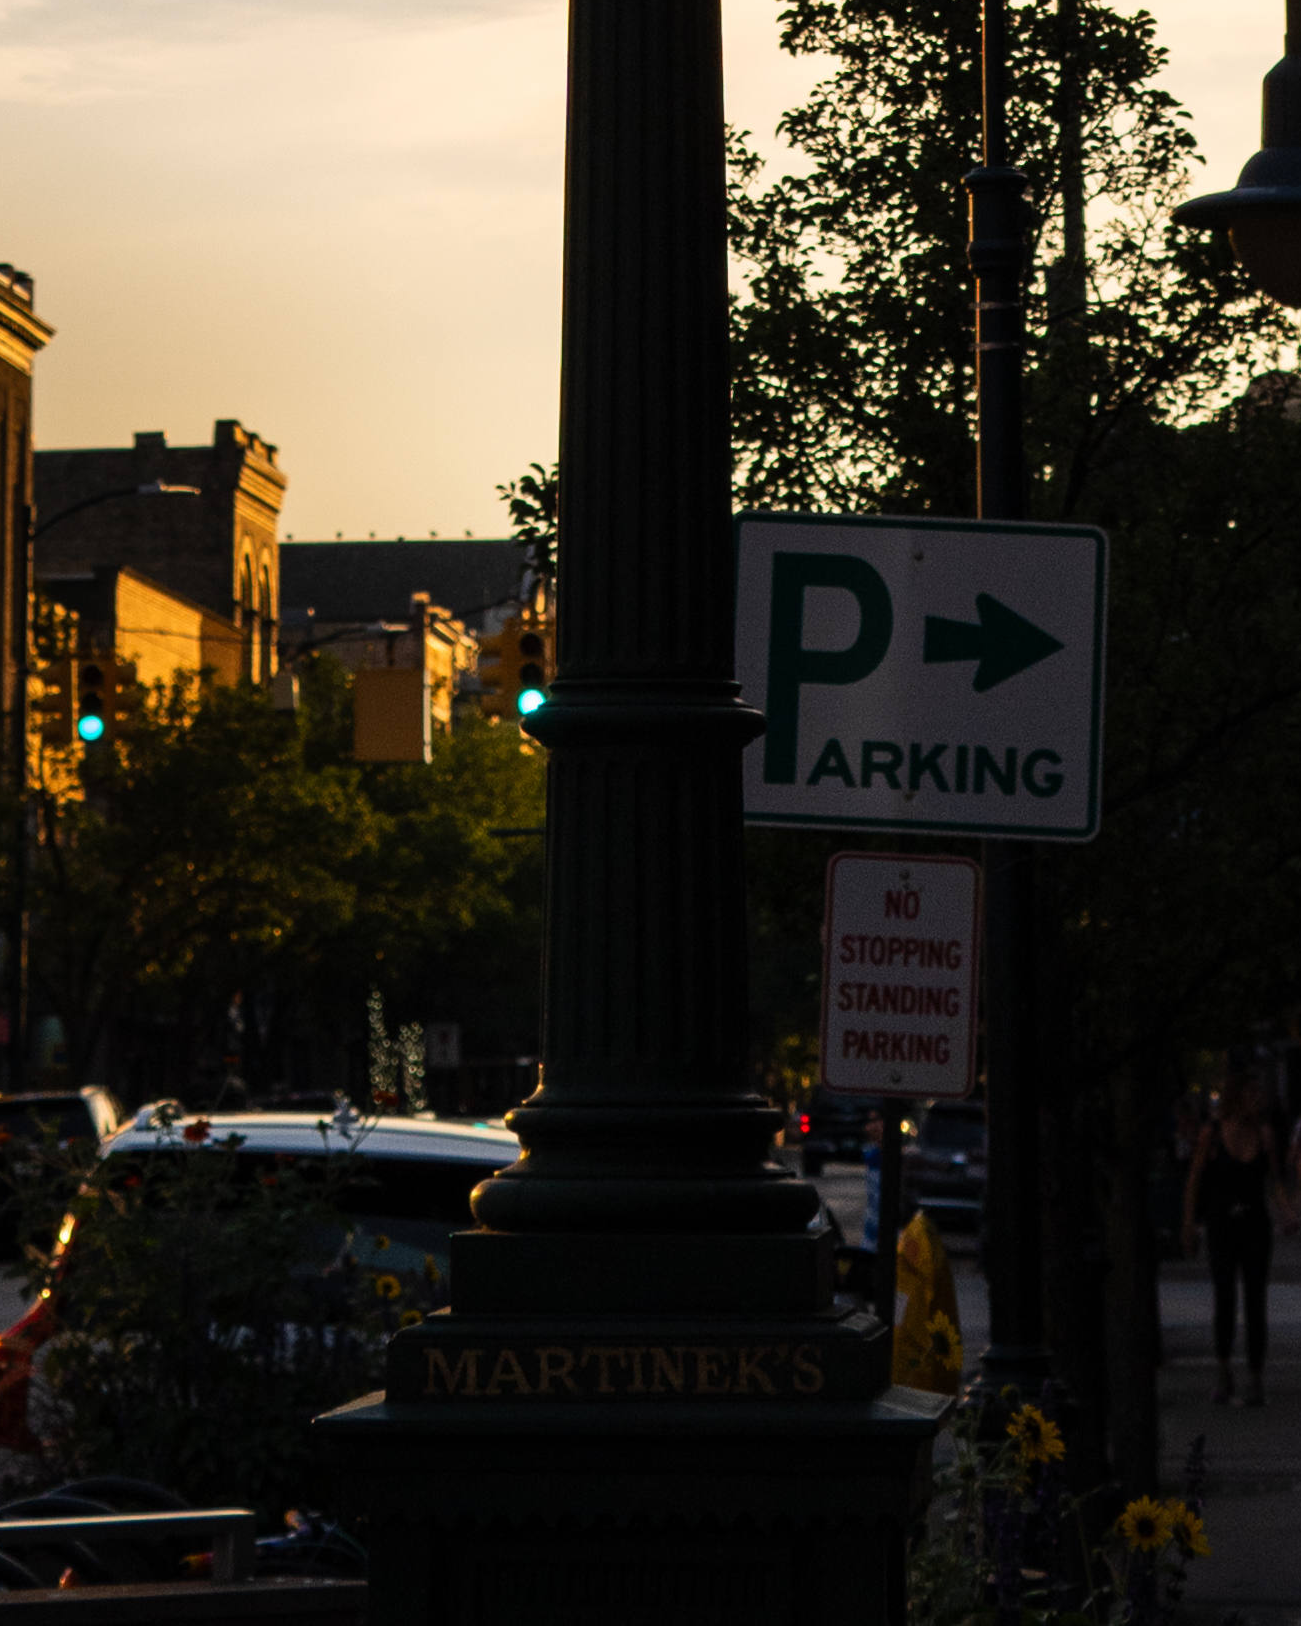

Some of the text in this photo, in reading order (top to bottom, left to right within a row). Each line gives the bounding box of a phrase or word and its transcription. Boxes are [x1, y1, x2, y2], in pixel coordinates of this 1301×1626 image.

[763, 551, 1065, 799] PARKING
[884, 889, 921, 920] NO
[839, 934, 962, 971] STOPPING
[837, 981, 961, 1018] STANDING
[842, 1030, 950, 1065] PARKING
[421, 1345, 827, 1396] MARTINEK'S
